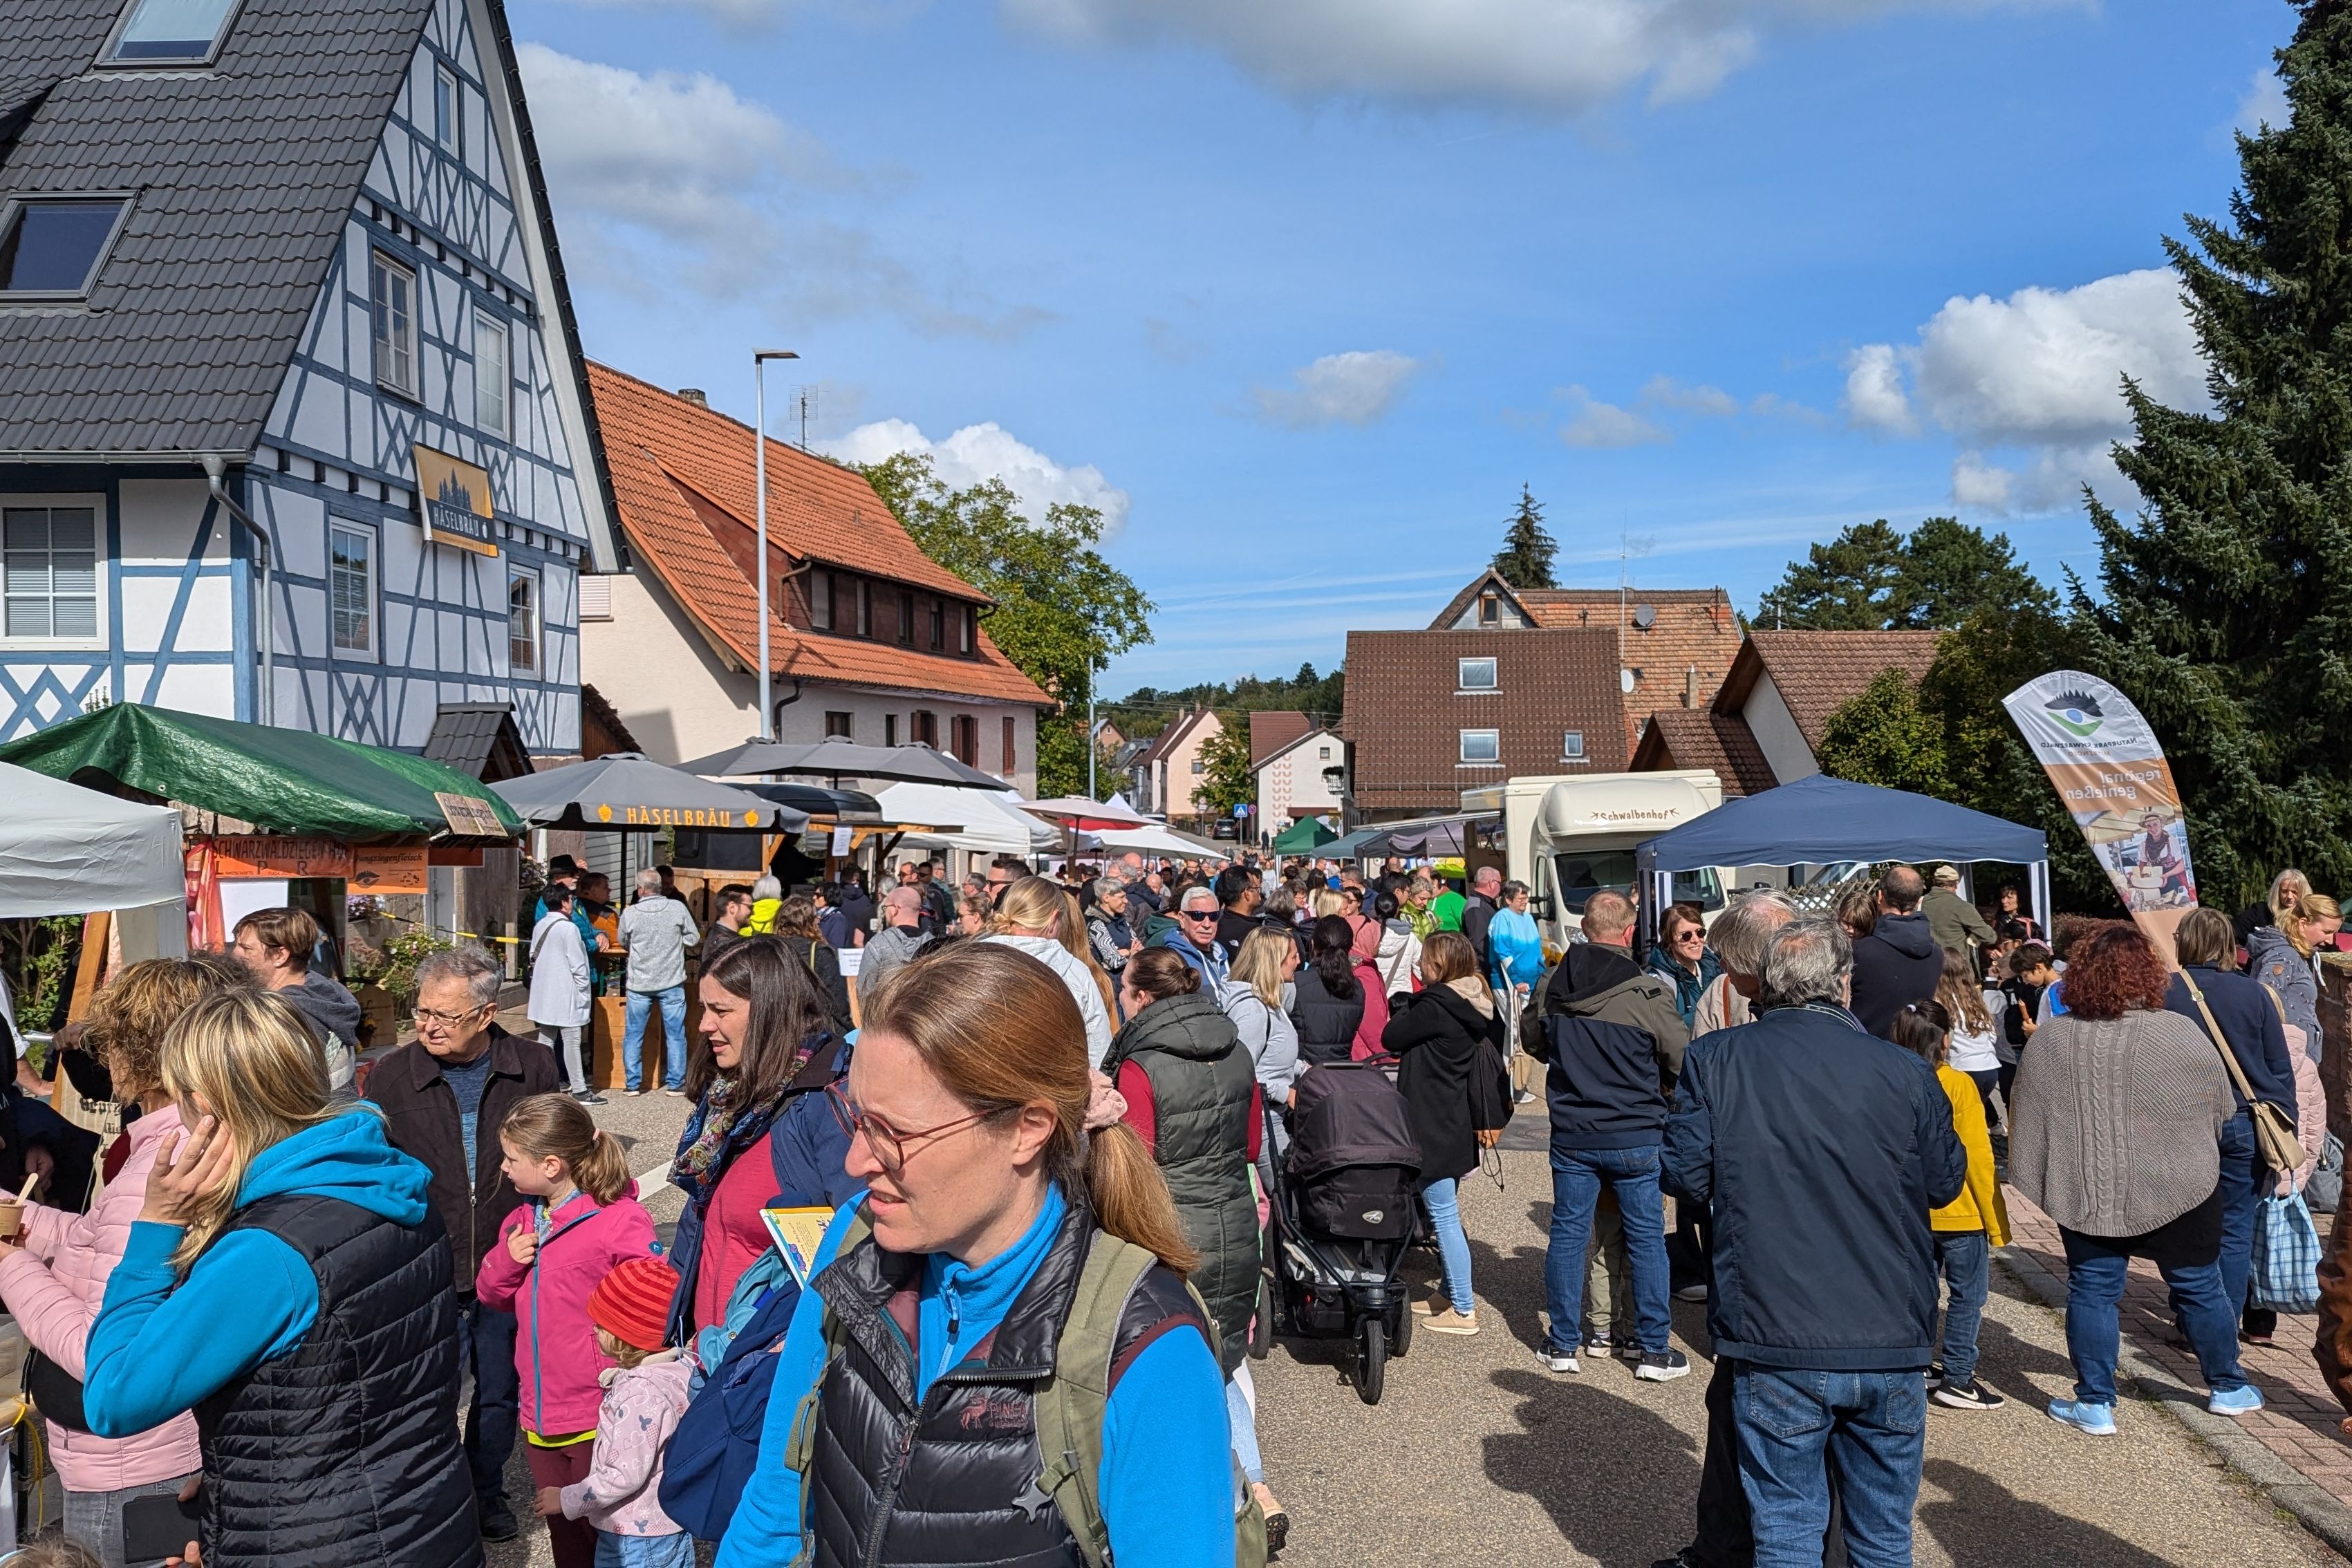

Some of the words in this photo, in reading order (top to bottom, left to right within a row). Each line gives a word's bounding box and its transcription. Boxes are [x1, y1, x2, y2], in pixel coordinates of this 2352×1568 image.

[433, 504, 480, 537] HÄSELBRÄU
[626, 805, 731, 828] HÄSELBRÄU
[1600, 809, 1669, 821] Schwalbenhof
